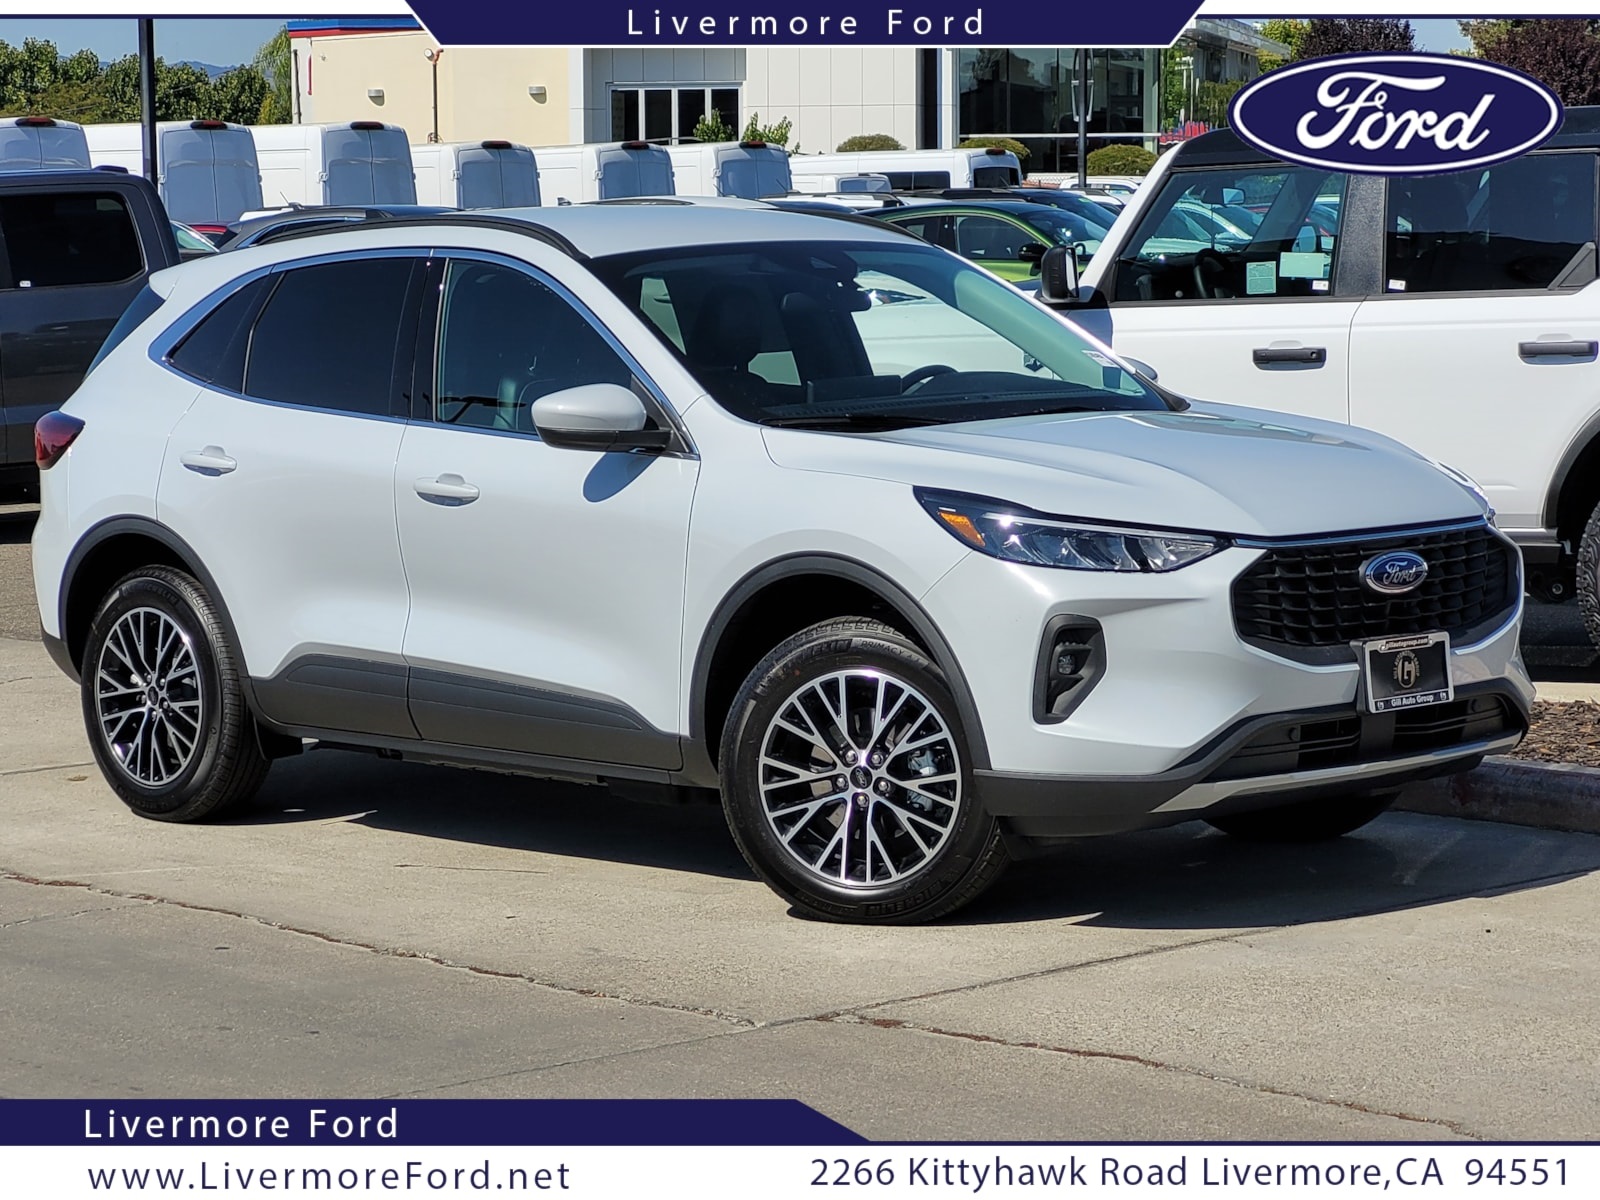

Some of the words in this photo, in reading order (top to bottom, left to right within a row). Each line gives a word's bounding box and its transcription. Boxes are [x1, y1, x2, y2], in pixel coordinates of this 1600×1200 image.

[1382, 561, 1416, 584] Ford
[860, 640, 906, 656] PRIMACY
[1391, 698, 1402, 707] Gill
[1402, 696, 1416, 705] Auto
[1416, 694, 1434, 703] Group
